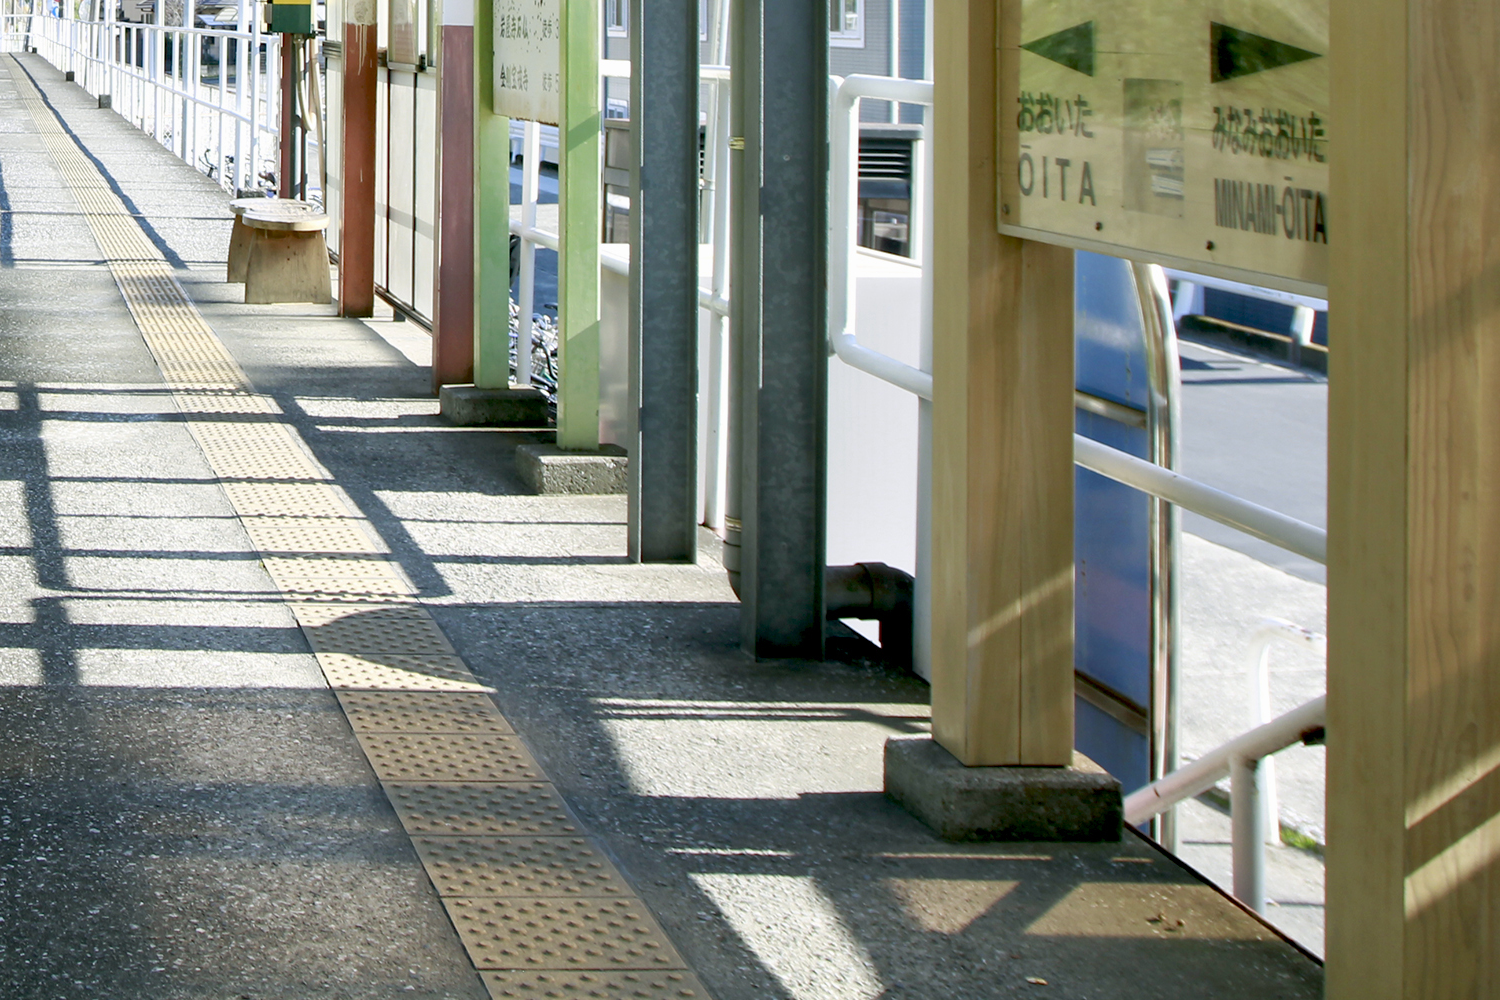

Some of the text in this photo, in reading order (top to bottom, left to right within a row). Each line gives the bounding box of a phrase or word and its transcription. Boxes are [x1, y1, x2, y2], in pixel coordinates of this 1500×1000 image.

[1016, 89, 1094, 140] おおいた
[1212, 105, 1327, 163] みなみおおいた
[1017, 144, 1096, 206] ŌITA
